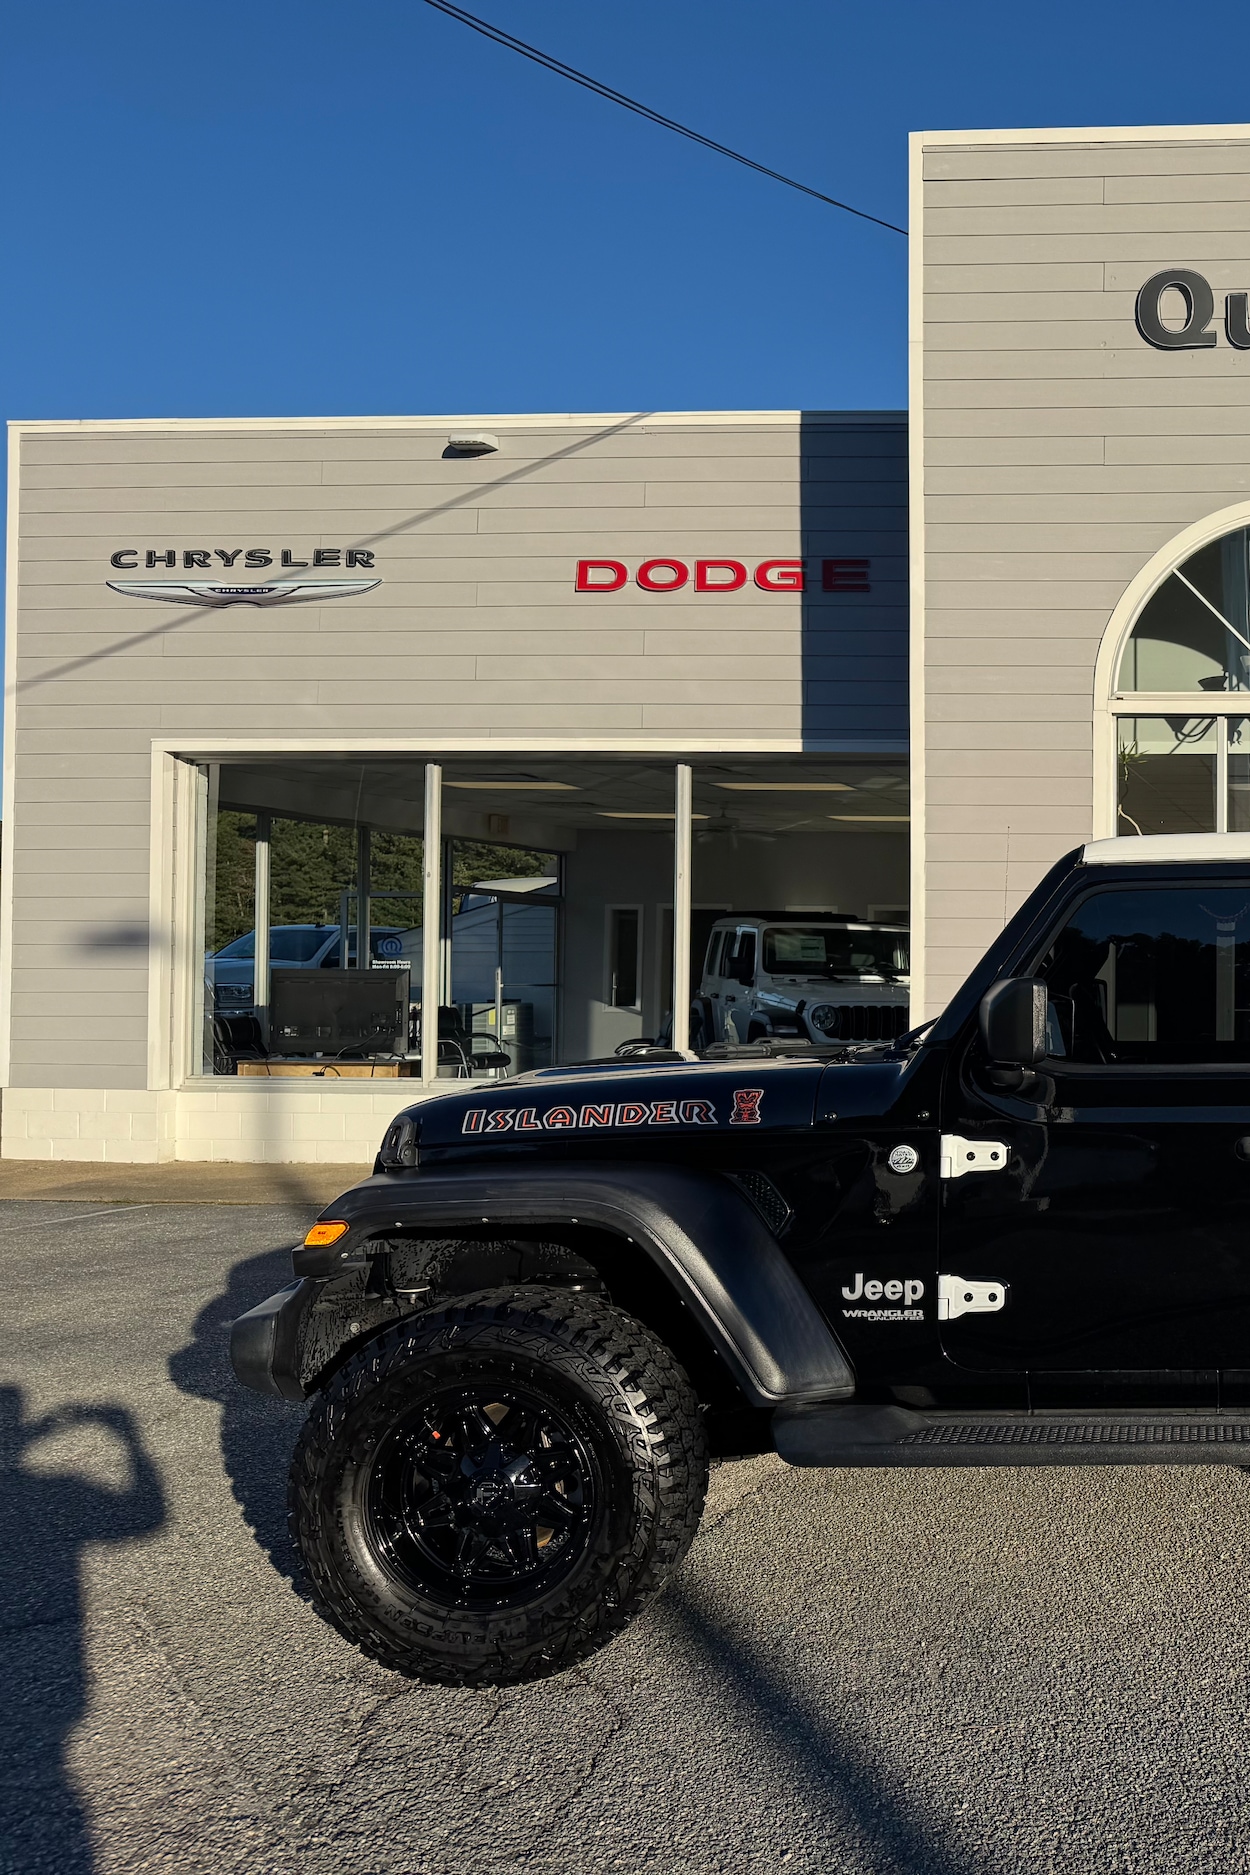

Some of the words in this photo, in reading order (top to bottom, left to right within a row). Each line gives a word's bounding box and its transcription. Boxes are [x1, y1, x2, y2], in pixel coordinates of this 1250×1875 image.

[110, 548, 375, 568] CHRYSLER
[575, 559, 870, 593] DODGE
[461, 1099, 719, 1134] ISLANDER
[841, 1272, 924, 1306] Jeep
[842, 1309, 924, 1318] WRANGLER
